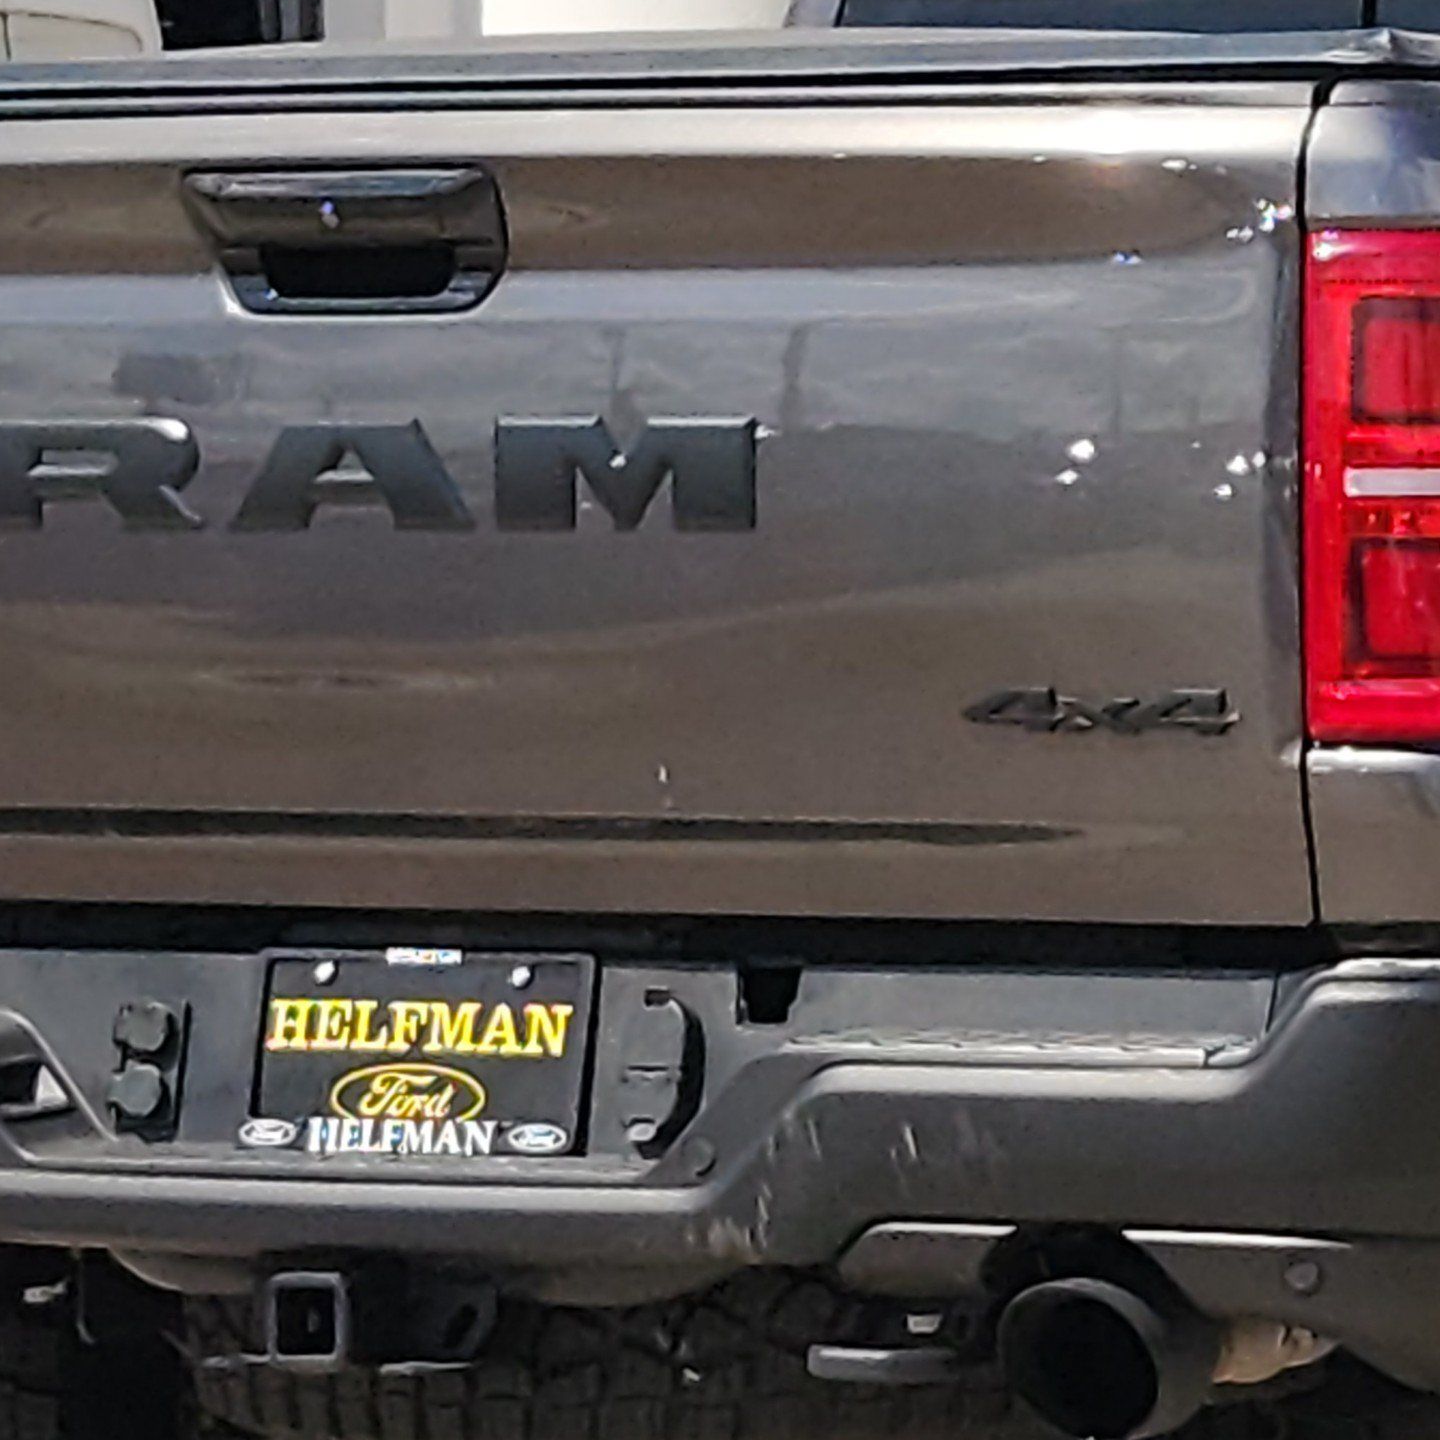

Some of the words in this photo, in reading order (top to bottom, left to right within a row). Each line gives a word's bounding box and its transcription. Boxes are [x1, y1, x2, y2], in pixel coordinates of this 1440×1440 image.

[266, 998, 573, 1056] HELFMAN
[359, 1071, 460, 1118] Ford
[306, 1116, 498, 1156] HELFMAN
